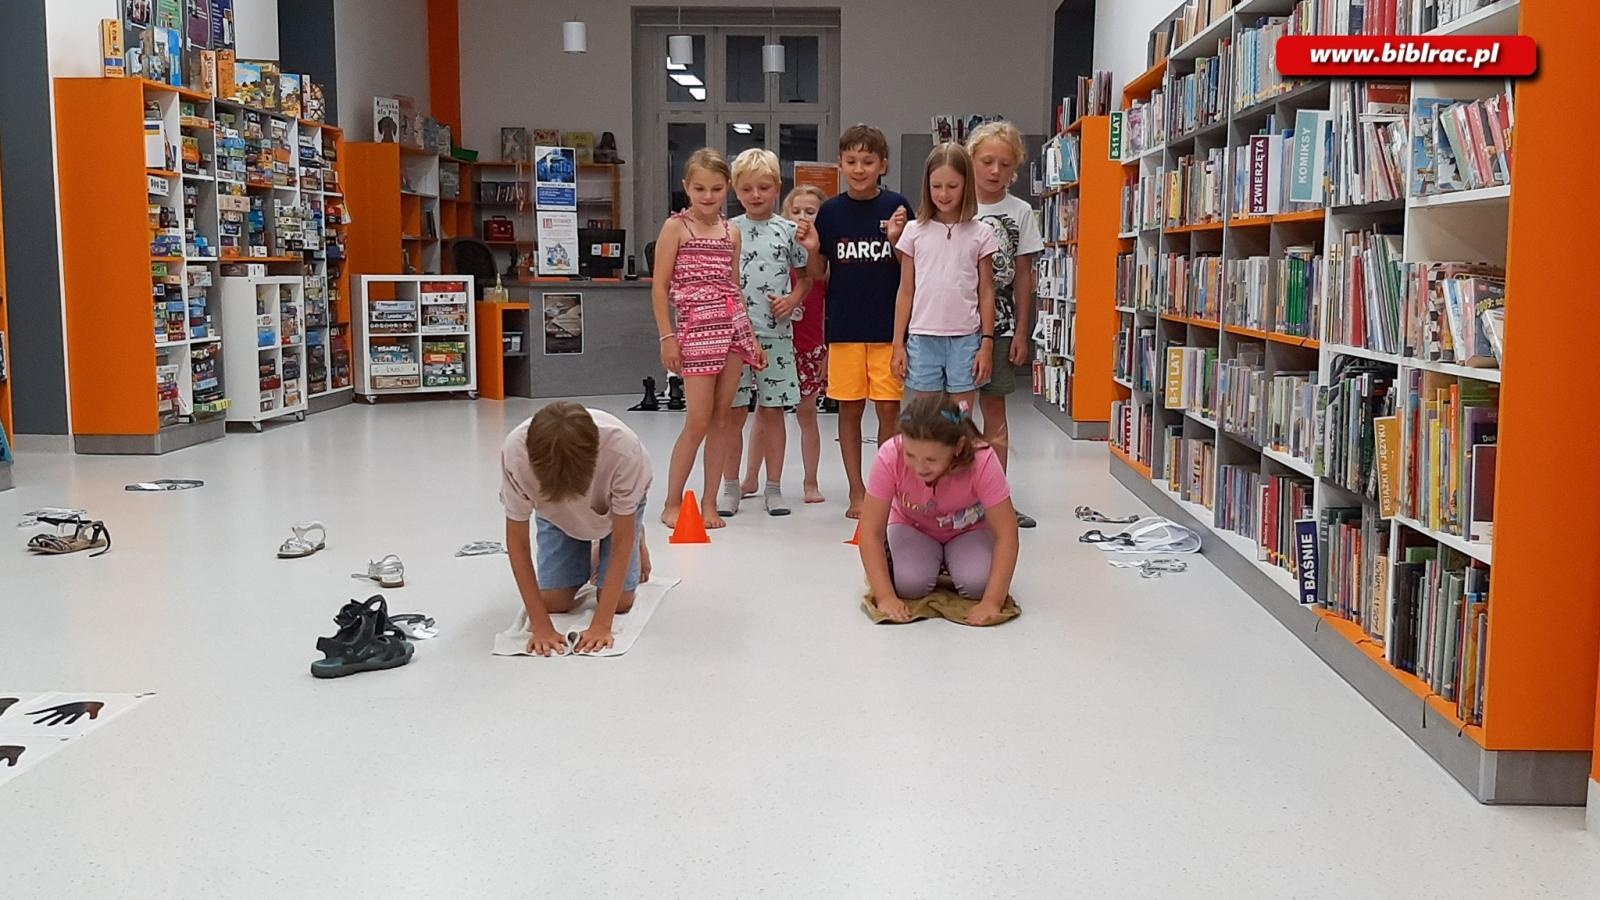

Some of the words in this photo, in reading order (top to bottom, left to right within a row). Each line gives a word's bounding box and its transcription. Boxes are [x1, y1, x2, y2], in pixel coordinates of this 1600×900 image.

[1298, 127, 1311, 184] KOMIKSY
[1254, 140, 1265, 205] ZWIERZĘTA
[837, 241, 892, 261] BARÇA
[1170, 352, 1180, 376] LAT
[1169, 380, 1179, 404] 8-11
[1381, 463, 1388, 471] W
[1300, 533, 1316, 590] BAŚNIE
[1306, 594, 1314, 603] B
